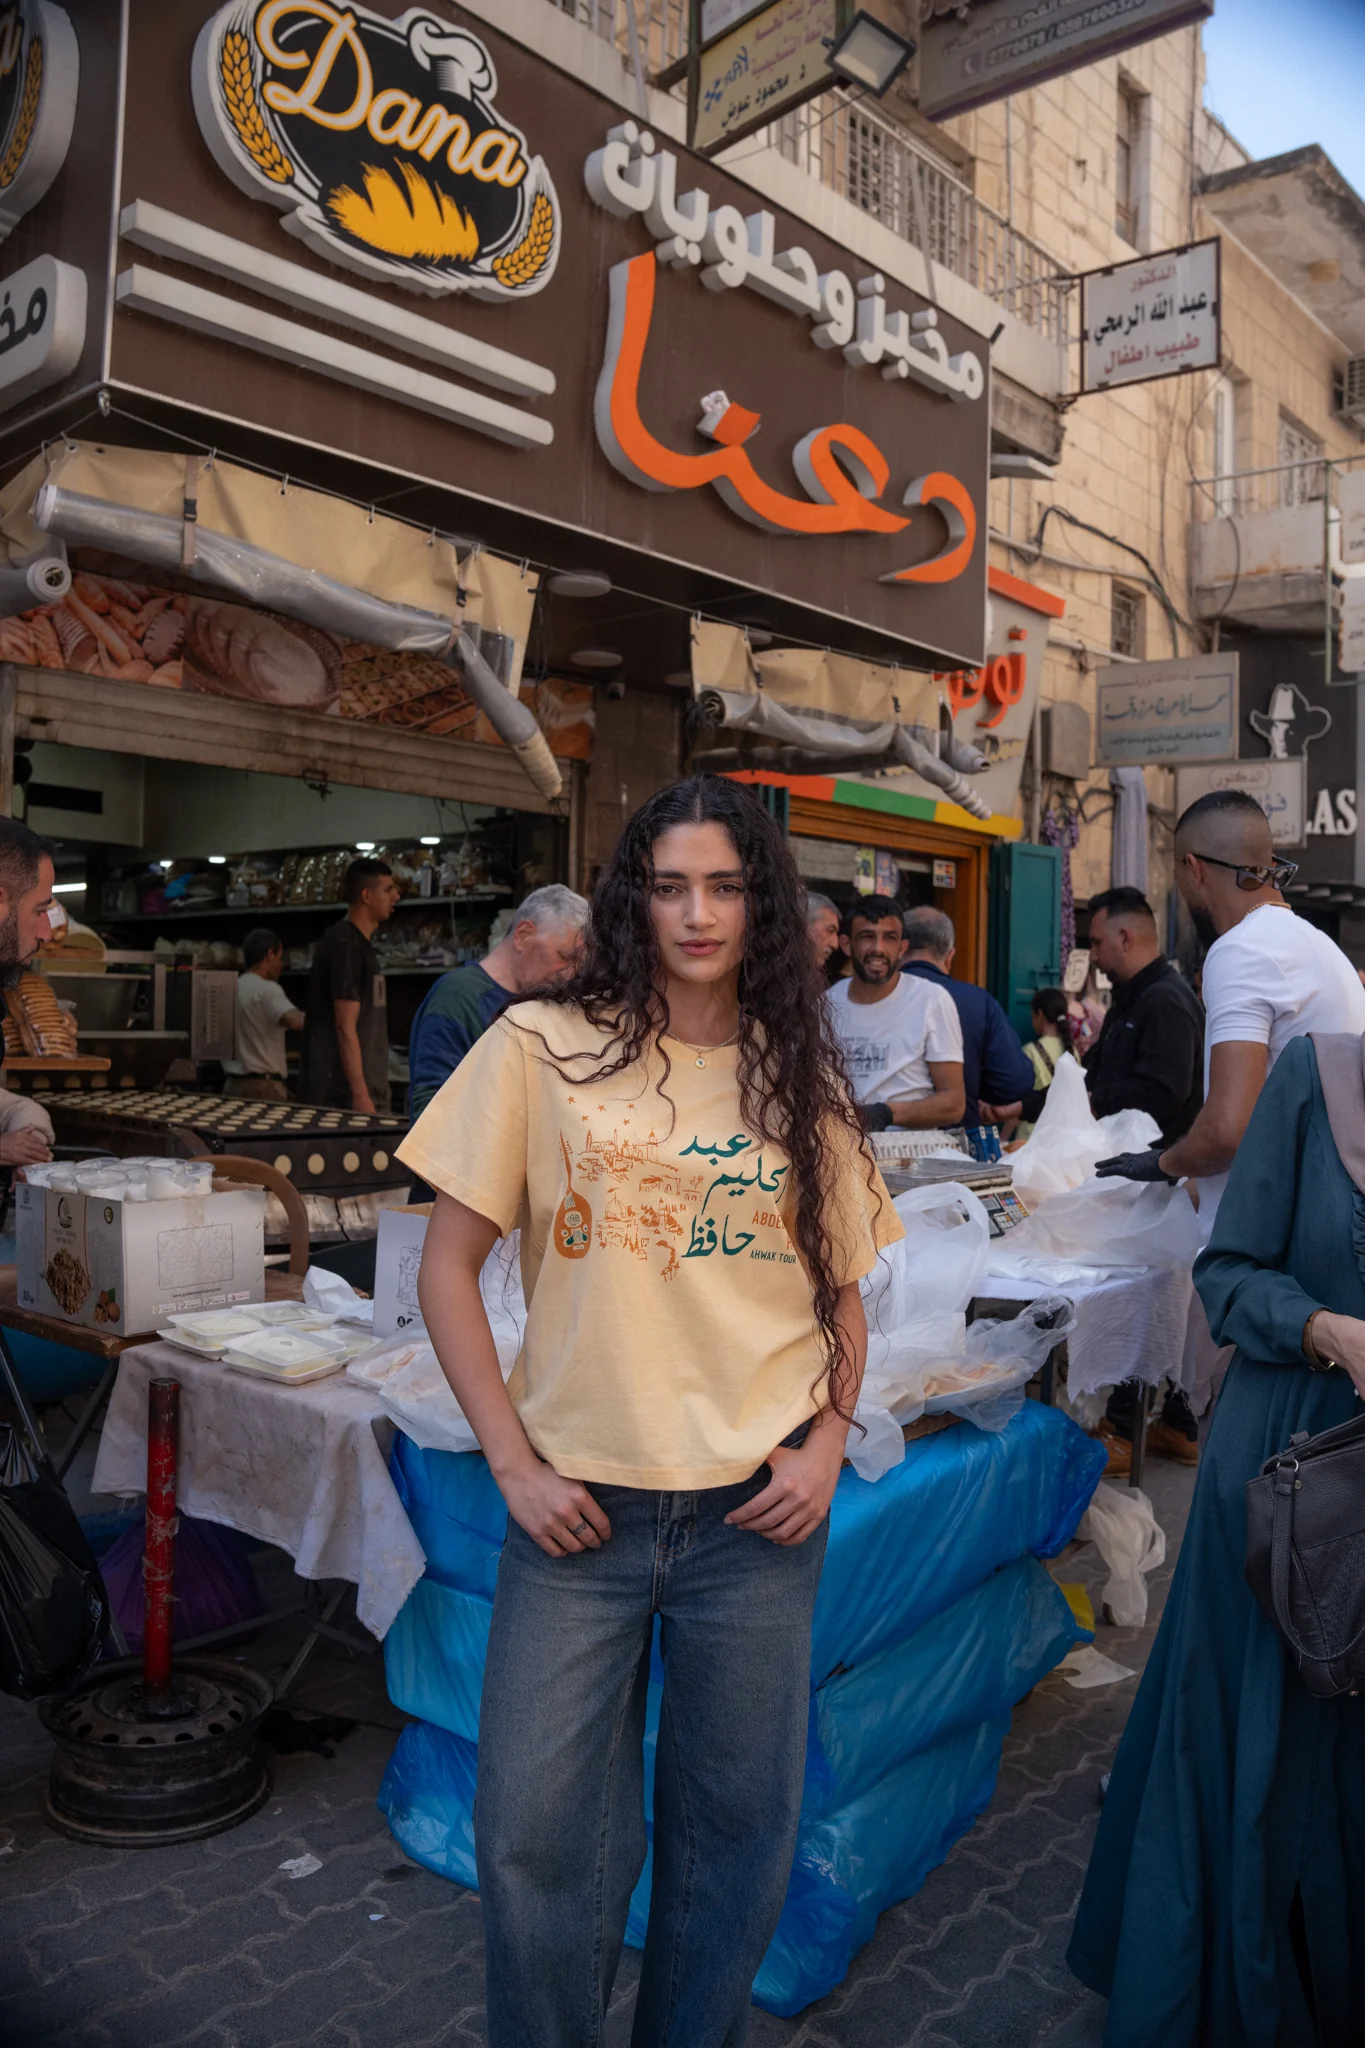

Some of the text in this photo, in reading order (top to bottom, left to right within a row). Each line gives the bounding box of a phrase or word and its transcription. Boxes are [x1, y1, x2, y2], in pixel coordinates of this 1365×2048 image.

[255, 0, 527, 187] Dana
[1130, 264, 1177, 293] الدكتور
[1150, 292, 1174, 321] الله
[1179, 292, 1208, 320] عبد
[841, 272, 985, 402] مخبز
[1103, 332, 1202, 375] طبيب اطفال
[1304, 787, 1358, 837] AS
[678, 1133, 753, 1167] عبد
[681, 1214, 756, 1258] حافظ
[749, 1249, 797, 1264] AHWAK TOUR
